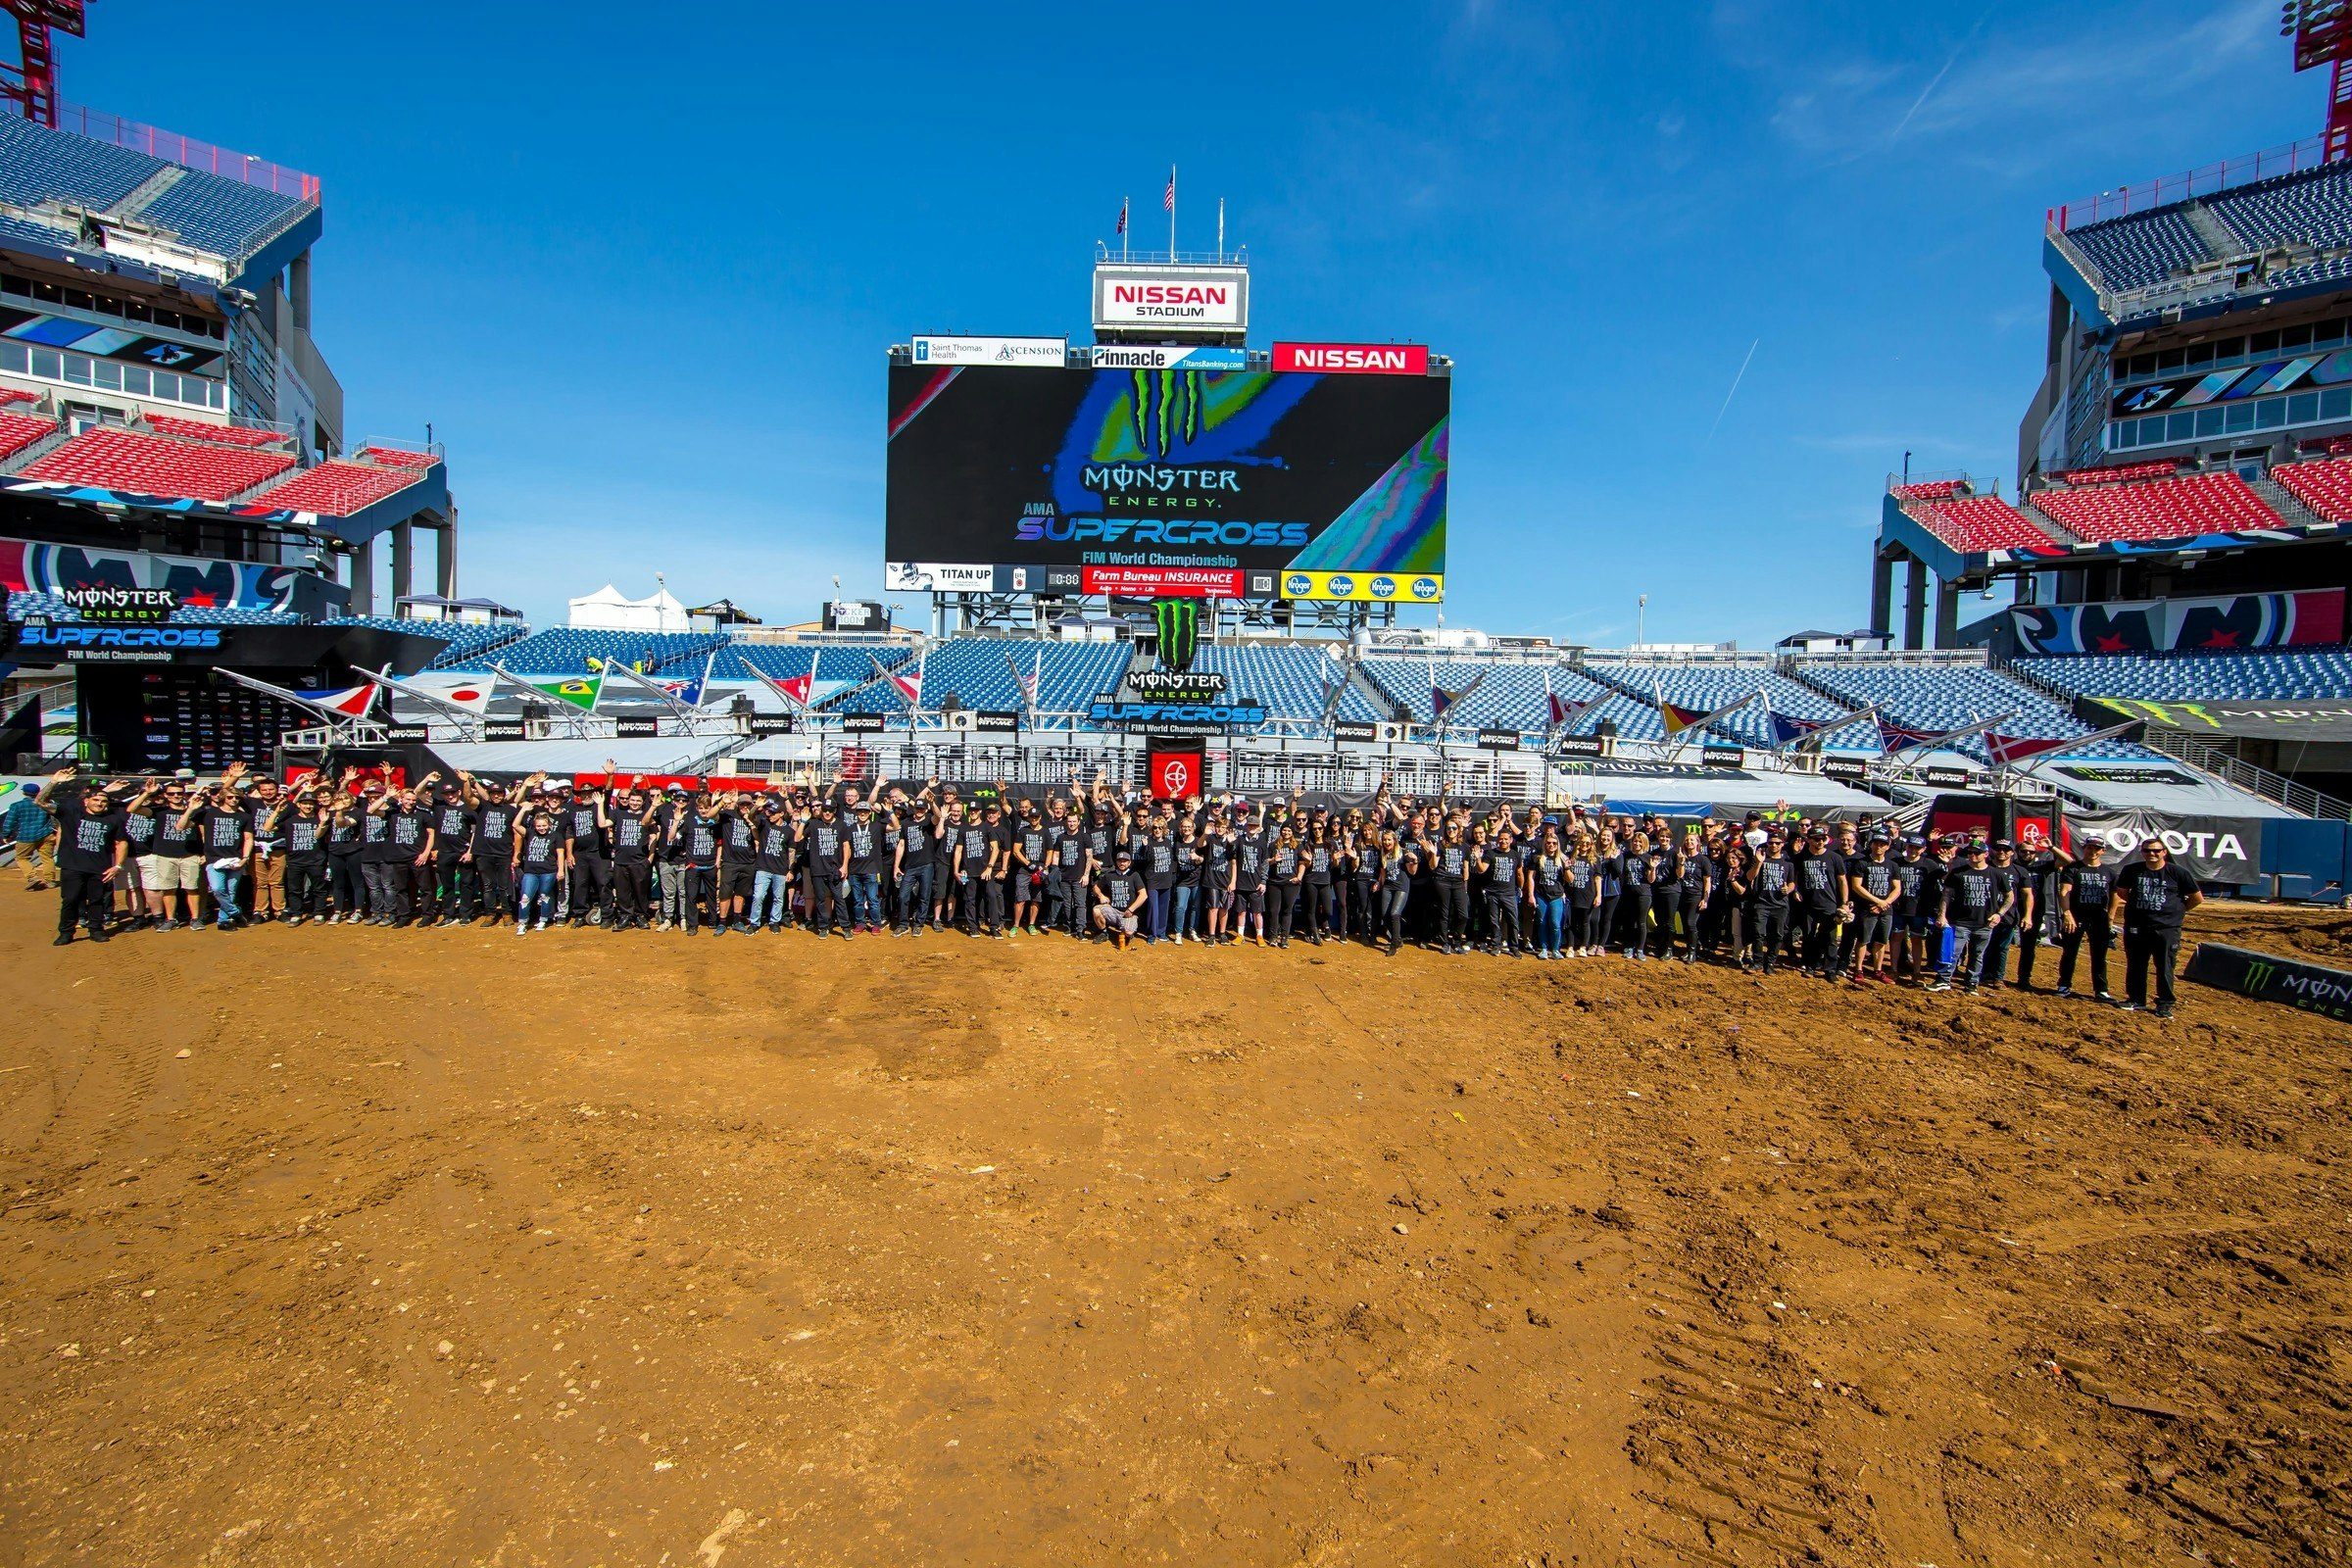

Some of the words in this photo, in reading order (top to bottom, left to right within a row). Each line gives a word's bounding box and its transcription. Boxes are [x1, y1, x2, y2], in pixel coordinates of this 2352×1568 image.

[1115, 286, 1226, 304] NISSAN
[1136, 307, 1204, 317] STADIUM
[1000, 346, 1062, 358] ASCENSION
[1094, 349, 1165, 367] Pinnacle
[1295, 349, 1405, 368] NISSAN
[1182, 360, 1244, 369] TitansBanking.com
[1084, 464, 1241, 492] MONSTER
[1023, 503, 1054, 515] AMA
[1014, 517, 1310, 546] SUPERCROSS
[1083, 552, 1105, 564] FIM
[1109, 552, 1147, 564] World
[1149, 553, 1238, 567] Championship
[940, 568, 975, 579] TITAN
[976, 569, 992, 579] UP
[1092, 570, 1120, 581] Farm
[1122, 571, 1161, 582] Bureau
[1164, 571, 1234, 583] INSURANCE
[1288, 577, 1310, 593] Kroger
[1329, 578, 1352, 594] Kroger
[1371, 579, 1395, 595] Kroger
[1414, 580, 1437, 596] Kroger
[67, 588, 174, 607] MONSTER
[24, 616, 46, 626] AMA
[20, 627, 220, 646] SUPERCROSS
[68, 650, 83, 659] FIM
[85, 650, 110, 660] World
[112, 651, 172, 662] Championship
[1129, 671, 1224, 689] MONSTER
[1095, 694, 1113, 704] AMA
[1090, 706, 1265, 722] SUPERCROSS
[1169, 725, 1222, 734] Championship
[78, 827, 105, 837] SHIRT
[77, 836, 104, 845] SAVES
[2137, 886, 2167, 895] SHIRT
[2297, 999, 2346, 1017] ENE
